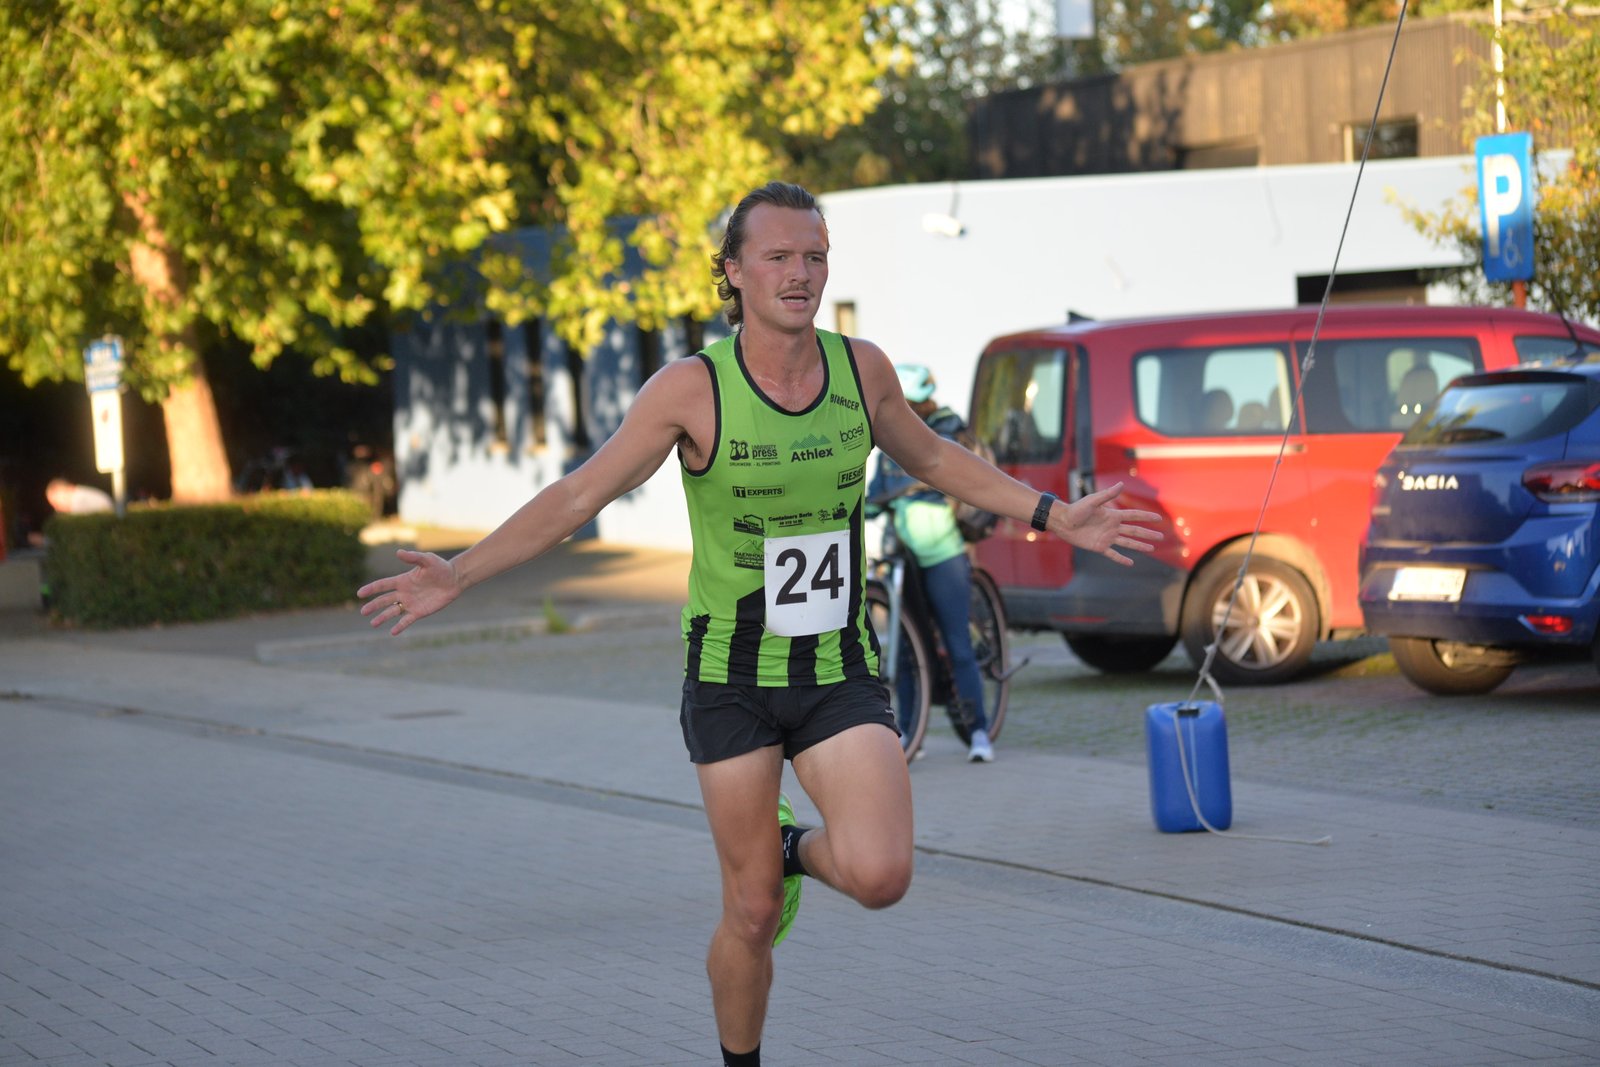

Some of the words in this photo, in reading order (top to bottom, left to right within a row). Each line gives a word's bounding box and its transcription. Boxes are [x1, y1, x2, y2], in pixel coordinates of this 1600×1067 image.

[1482, 154, 1522, 257] P
[752, 450, 778, 460] press
[790, 447, 834, 463] Athlex
[1402, 474, 1459, 491] DACIA
[747, 487, 783, 496] EXPERTS
[775, 543, 844, 606] 24
